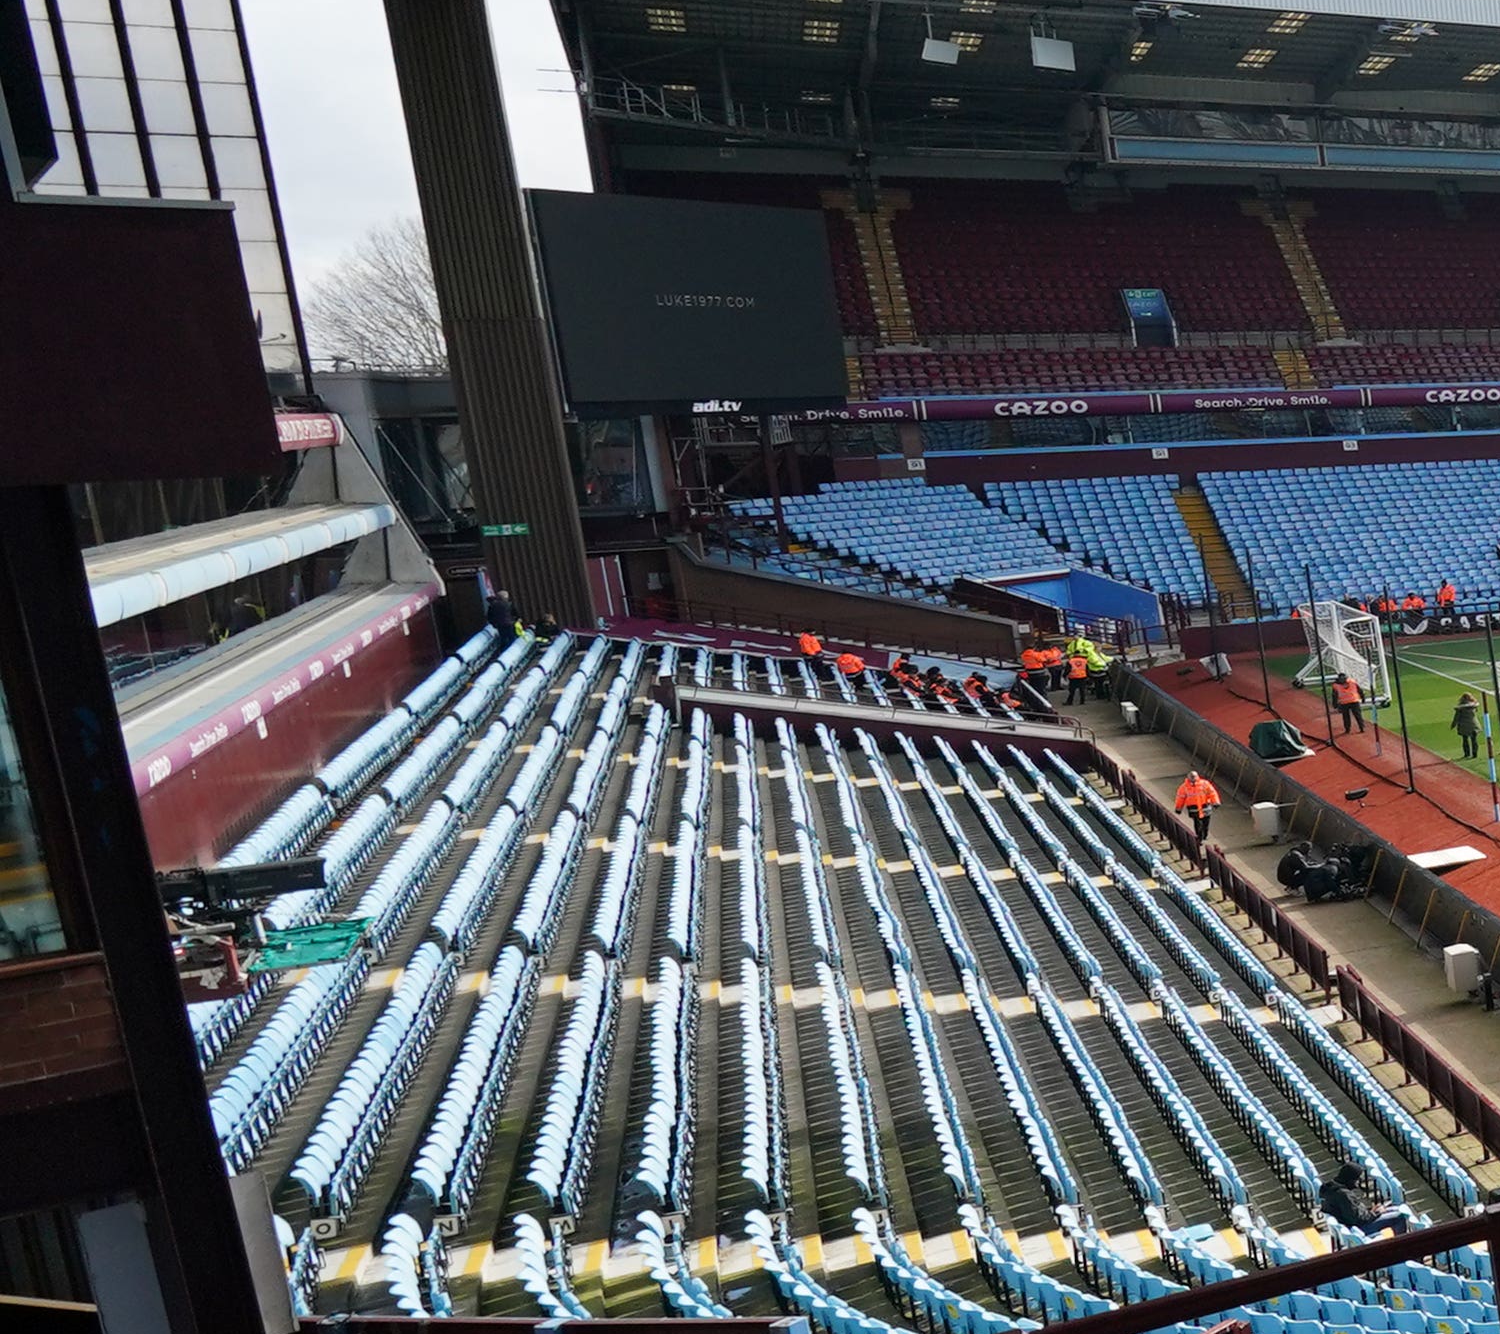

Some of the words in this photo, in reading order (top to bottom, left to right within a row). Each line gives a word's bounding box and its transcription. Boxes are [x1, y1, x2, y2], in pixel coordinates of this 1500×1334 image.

[655, 294, 755, 308] LUKE1977.COM
[1194, 397, 1246, 409] Search.
[1247, 396, 1288, 407] Drive.
[1290, 394, 1332, 406] Smile.
[1425, 388, 1500, 403] CAZOO
[692, 399, 742, 413] adi.tv
[994, 400, 1088, 416] CAZOO
[316, 1223, 331, 1235] O
[439, 1221, 454, 1232] N
